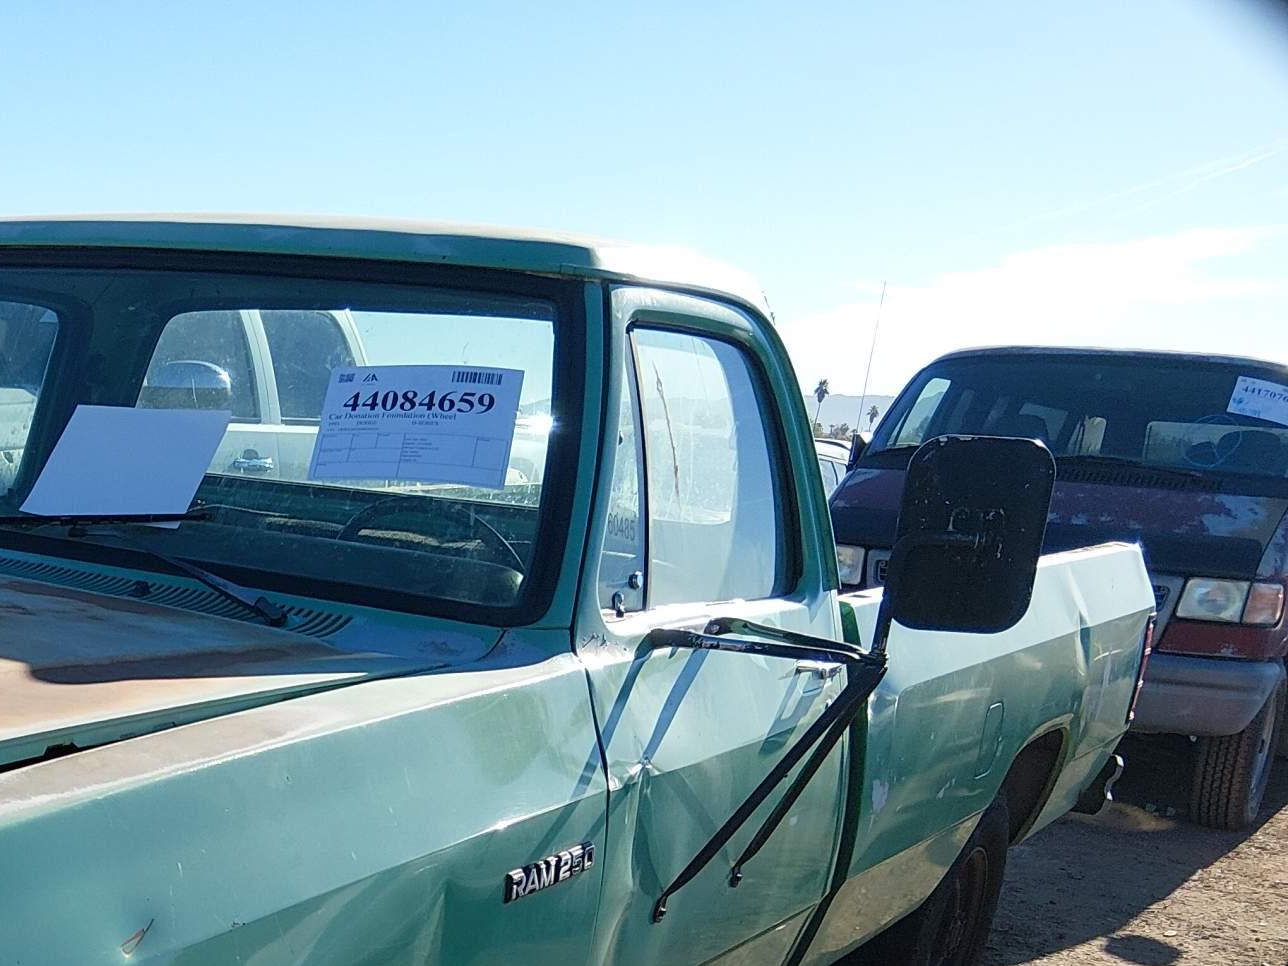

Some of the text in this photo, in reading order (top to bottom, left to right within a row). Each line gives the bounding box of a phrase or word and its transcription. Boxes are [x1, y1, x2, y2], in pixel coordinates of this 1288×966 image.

[343, 390, 496, 415] 44084659
[343, 411, 380, 419] Donation
[381, 411, 425, 419] Foundation
[504, 841, 596, 905] RAM 250
